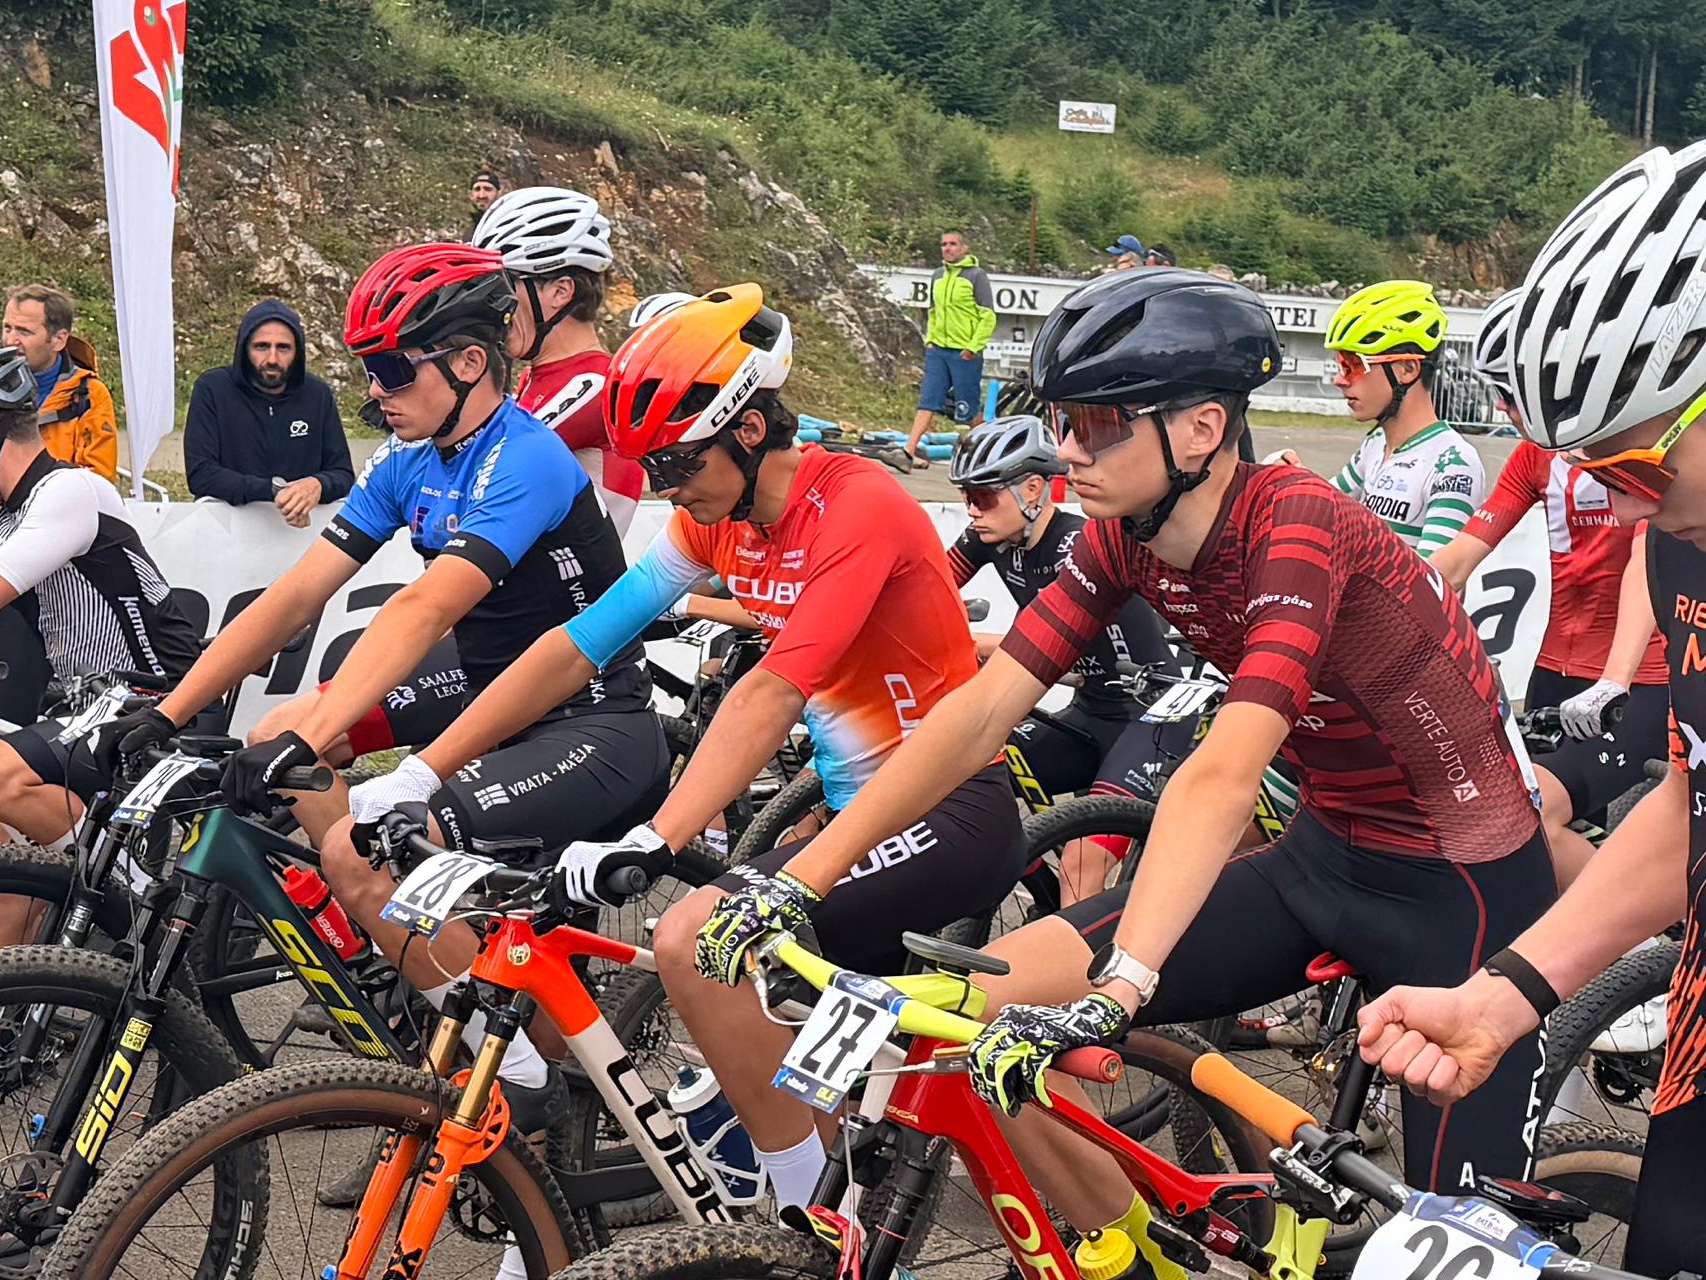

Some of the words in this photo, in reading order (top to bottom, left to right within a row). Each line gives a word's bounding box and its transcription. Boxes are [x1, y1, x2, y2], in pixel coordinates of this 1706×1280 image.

[711, 368, 761, 429] CUBE
[1363, 493, 1411, 522] ARDIA
[1571, 514, 1621, 528] DENMARK
[569, 583, 590, 613] VRA
[118, 595, 166, 677] kamemo
[418, 668, 468, 690] SAALFE
[1404, 690, 1448, 741] VERTE
[1435, 733, 1466, 782] AUTO
[508, 771, 553, 798] VRATA
[405, 857, 479, 911] 28
[834, 821, 940, 887] UBE
[272, 918, 390, 1058] SCO
[799, 996, 877, 1081] 27
[74, 1053, 135, 1166] SID
